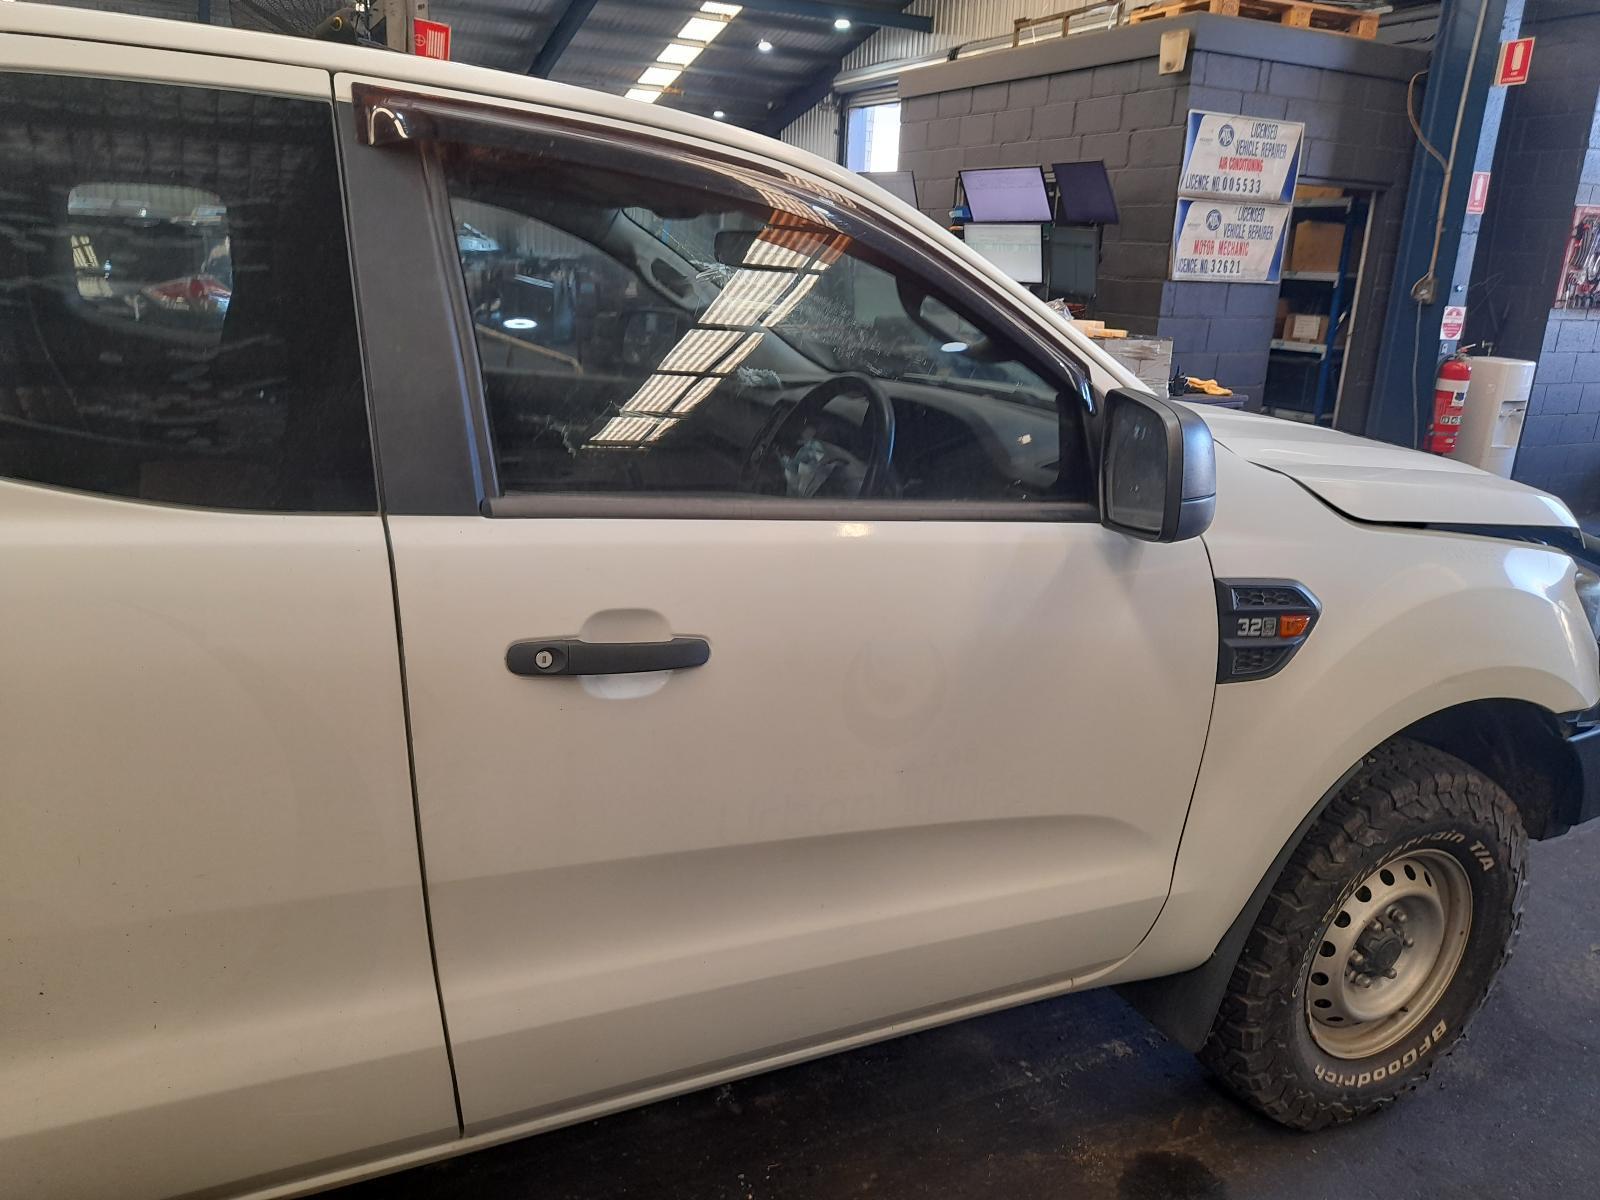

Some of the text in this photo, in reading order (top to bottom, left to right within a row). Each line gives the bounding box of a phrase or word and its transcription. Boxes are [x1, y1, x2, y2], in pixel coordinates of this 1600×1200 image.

[1250, 121, 1279, 140] LICENSED
[1235, 139, 1259, 157] VEHICLE
[1260, 141, 1288, 159] REPAIRER
[1218, 156, 1264, 172] AIR CONDITIONING
[1185, 174, 1209, 191] LICENCE
[1222, 176, 1261, 193] 005533
[1237, 206, 1266, 222] LICENSED
[1223, 223, 1274, 240] VEHICLE REPAIRER
[1192, 240, 1250, 256] MOTOR MECHANIC
[1210, 259, 1241, 274] 32621
[1314, 1019, 1447, 1088] BFGoodrich
